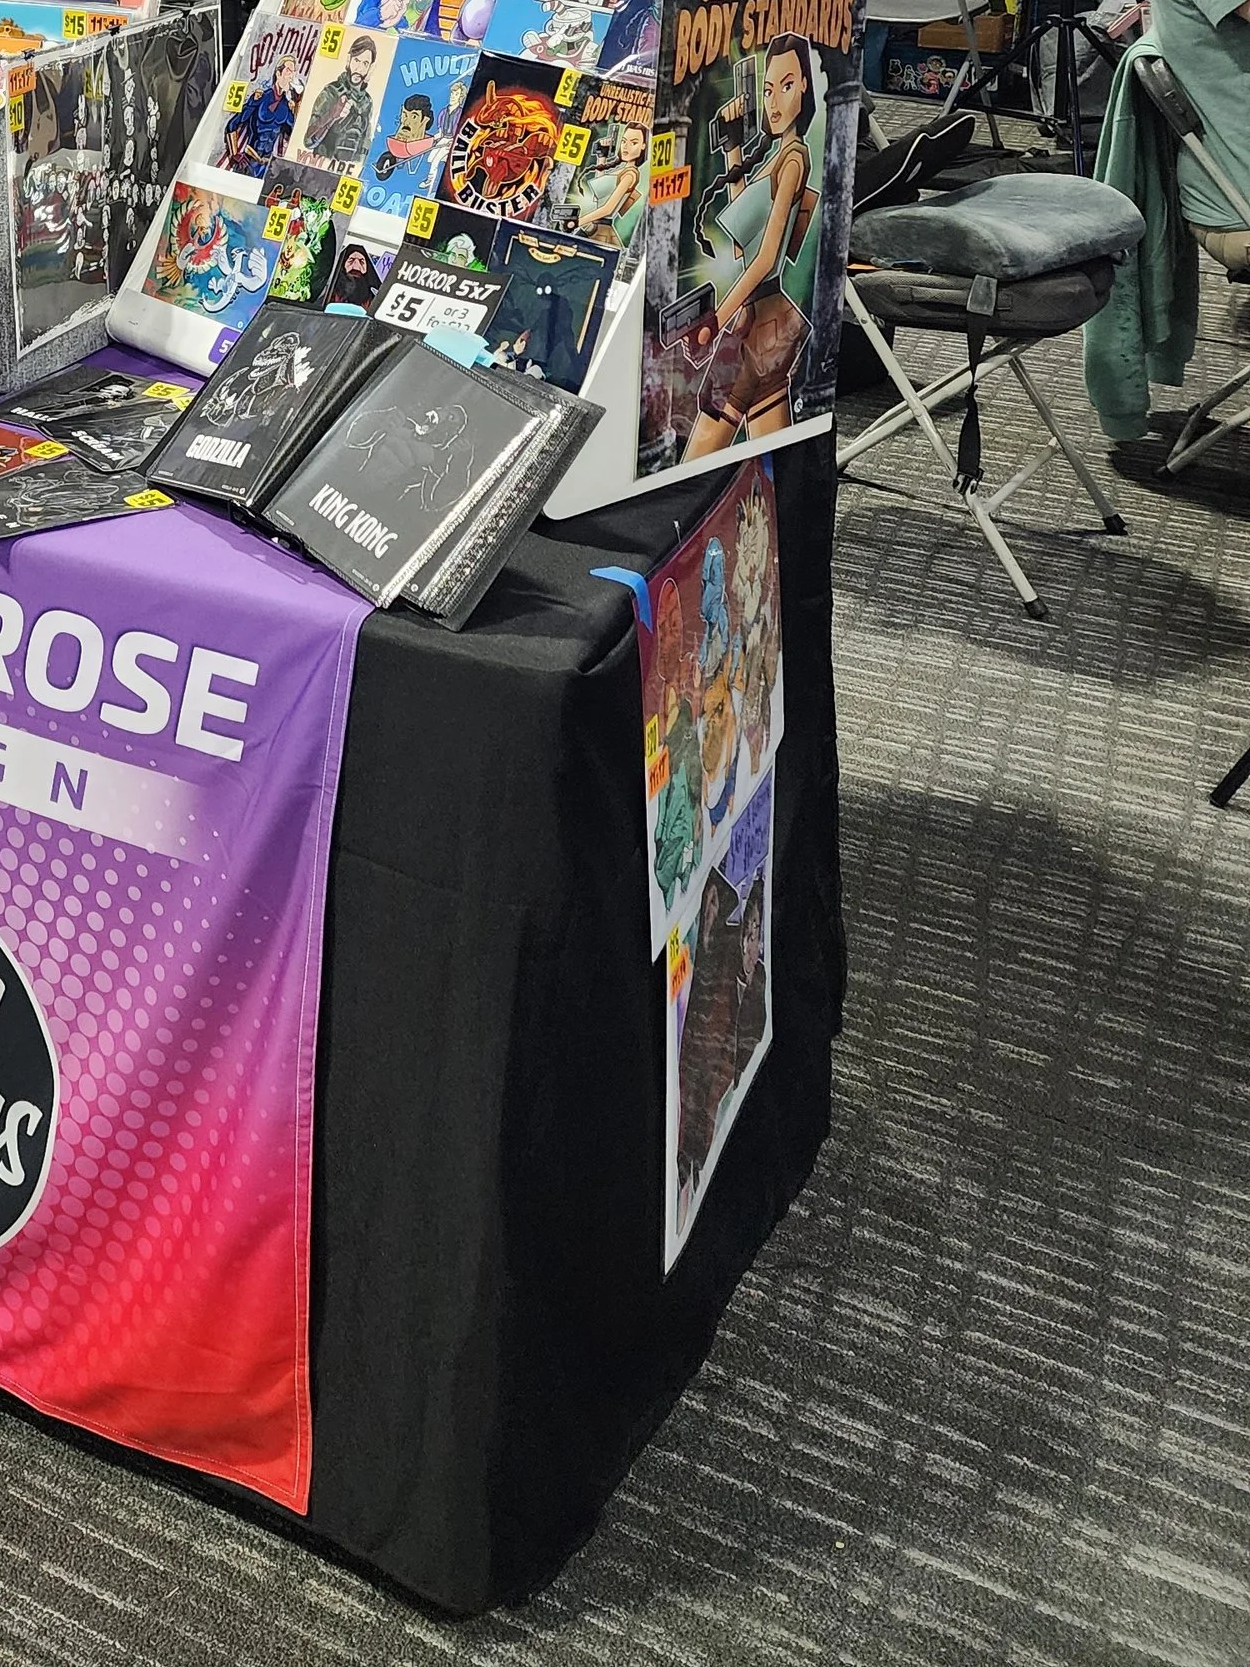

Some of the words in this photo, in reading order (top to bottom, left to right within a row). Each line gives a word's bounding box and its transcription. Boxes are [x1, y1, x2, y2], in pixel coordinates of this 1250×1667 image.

[64, 12, 86, 37] $15
[250, 24, 285, 82] got
[321, 28, 342, 54] $5
[673, 2, 739, 86] BODY
[229, 84, 247, 109] $5
[580, 95, 617, 123] BODY
[600, 83, 648, 105] UNREALISTIC
[452, 121, 480, 179] BALL
[559, 128, 586, 160] $5
[651, 138, 672, 167] $20
[296, 148, 325, 169] YOU
[328, 158, 356, 177] ARE
[335, 182, 359, 209] $5
[457, 182, 543, 218] BUSTER
[267, 210, 290, 238] $5
[410, 202, 435, 233] $5
[396, 260, 458, 294] HORROR
[386, 291, 425, 323] $5
[443, 307, 460, 318] or
[459, 307, 470, 320] 3
[152, 384, 177, 397] $5
[71, 429, 126, 462] SCREAM
[185, 434, 252, 469] GODZILLA
[308, 483, 359, 530] KING
[344, 510, 399, 560] KONG
